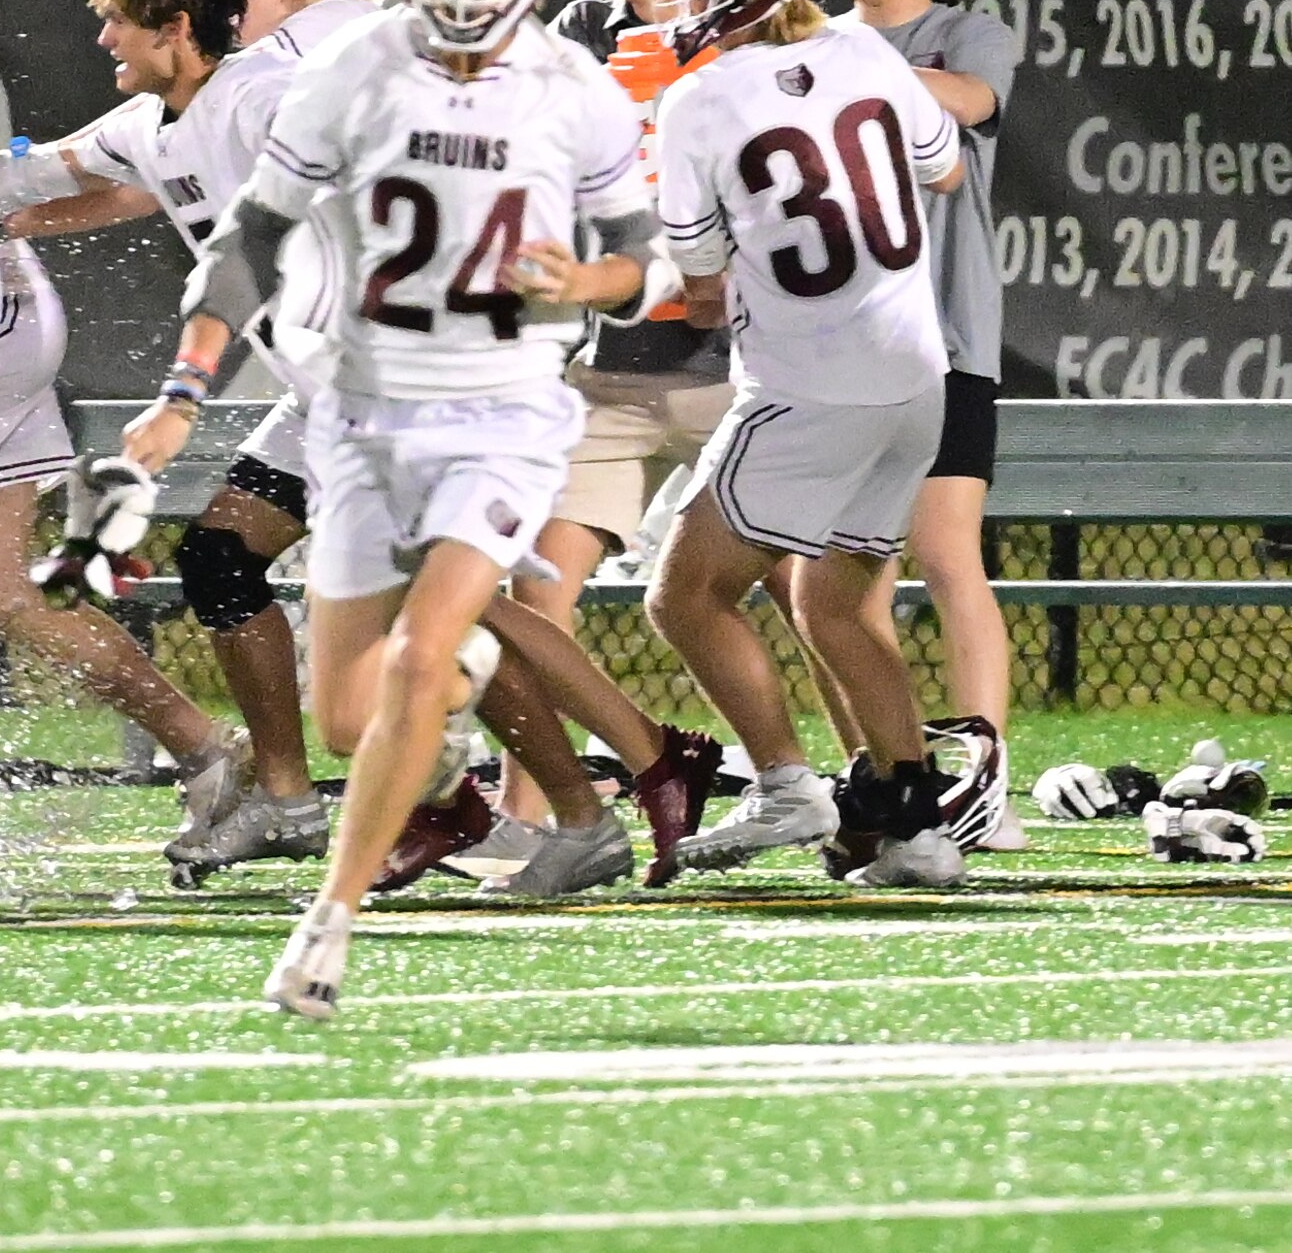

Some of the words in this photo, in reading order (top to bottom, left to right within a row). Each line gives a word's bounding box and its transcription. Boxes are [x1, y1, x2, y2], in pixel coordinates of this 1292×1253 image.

[407, 130, 509, 171] BRUINS
[1067, 112, 1292, 195] Confere
[739, 97, 922, 297] 30
[361, 175, 528, 339] 24
[995, 215, 1100, 298] 013,
[1113, 216, 1257, 300] 2014,
[1055, 335, 1208, 399] ECAC
